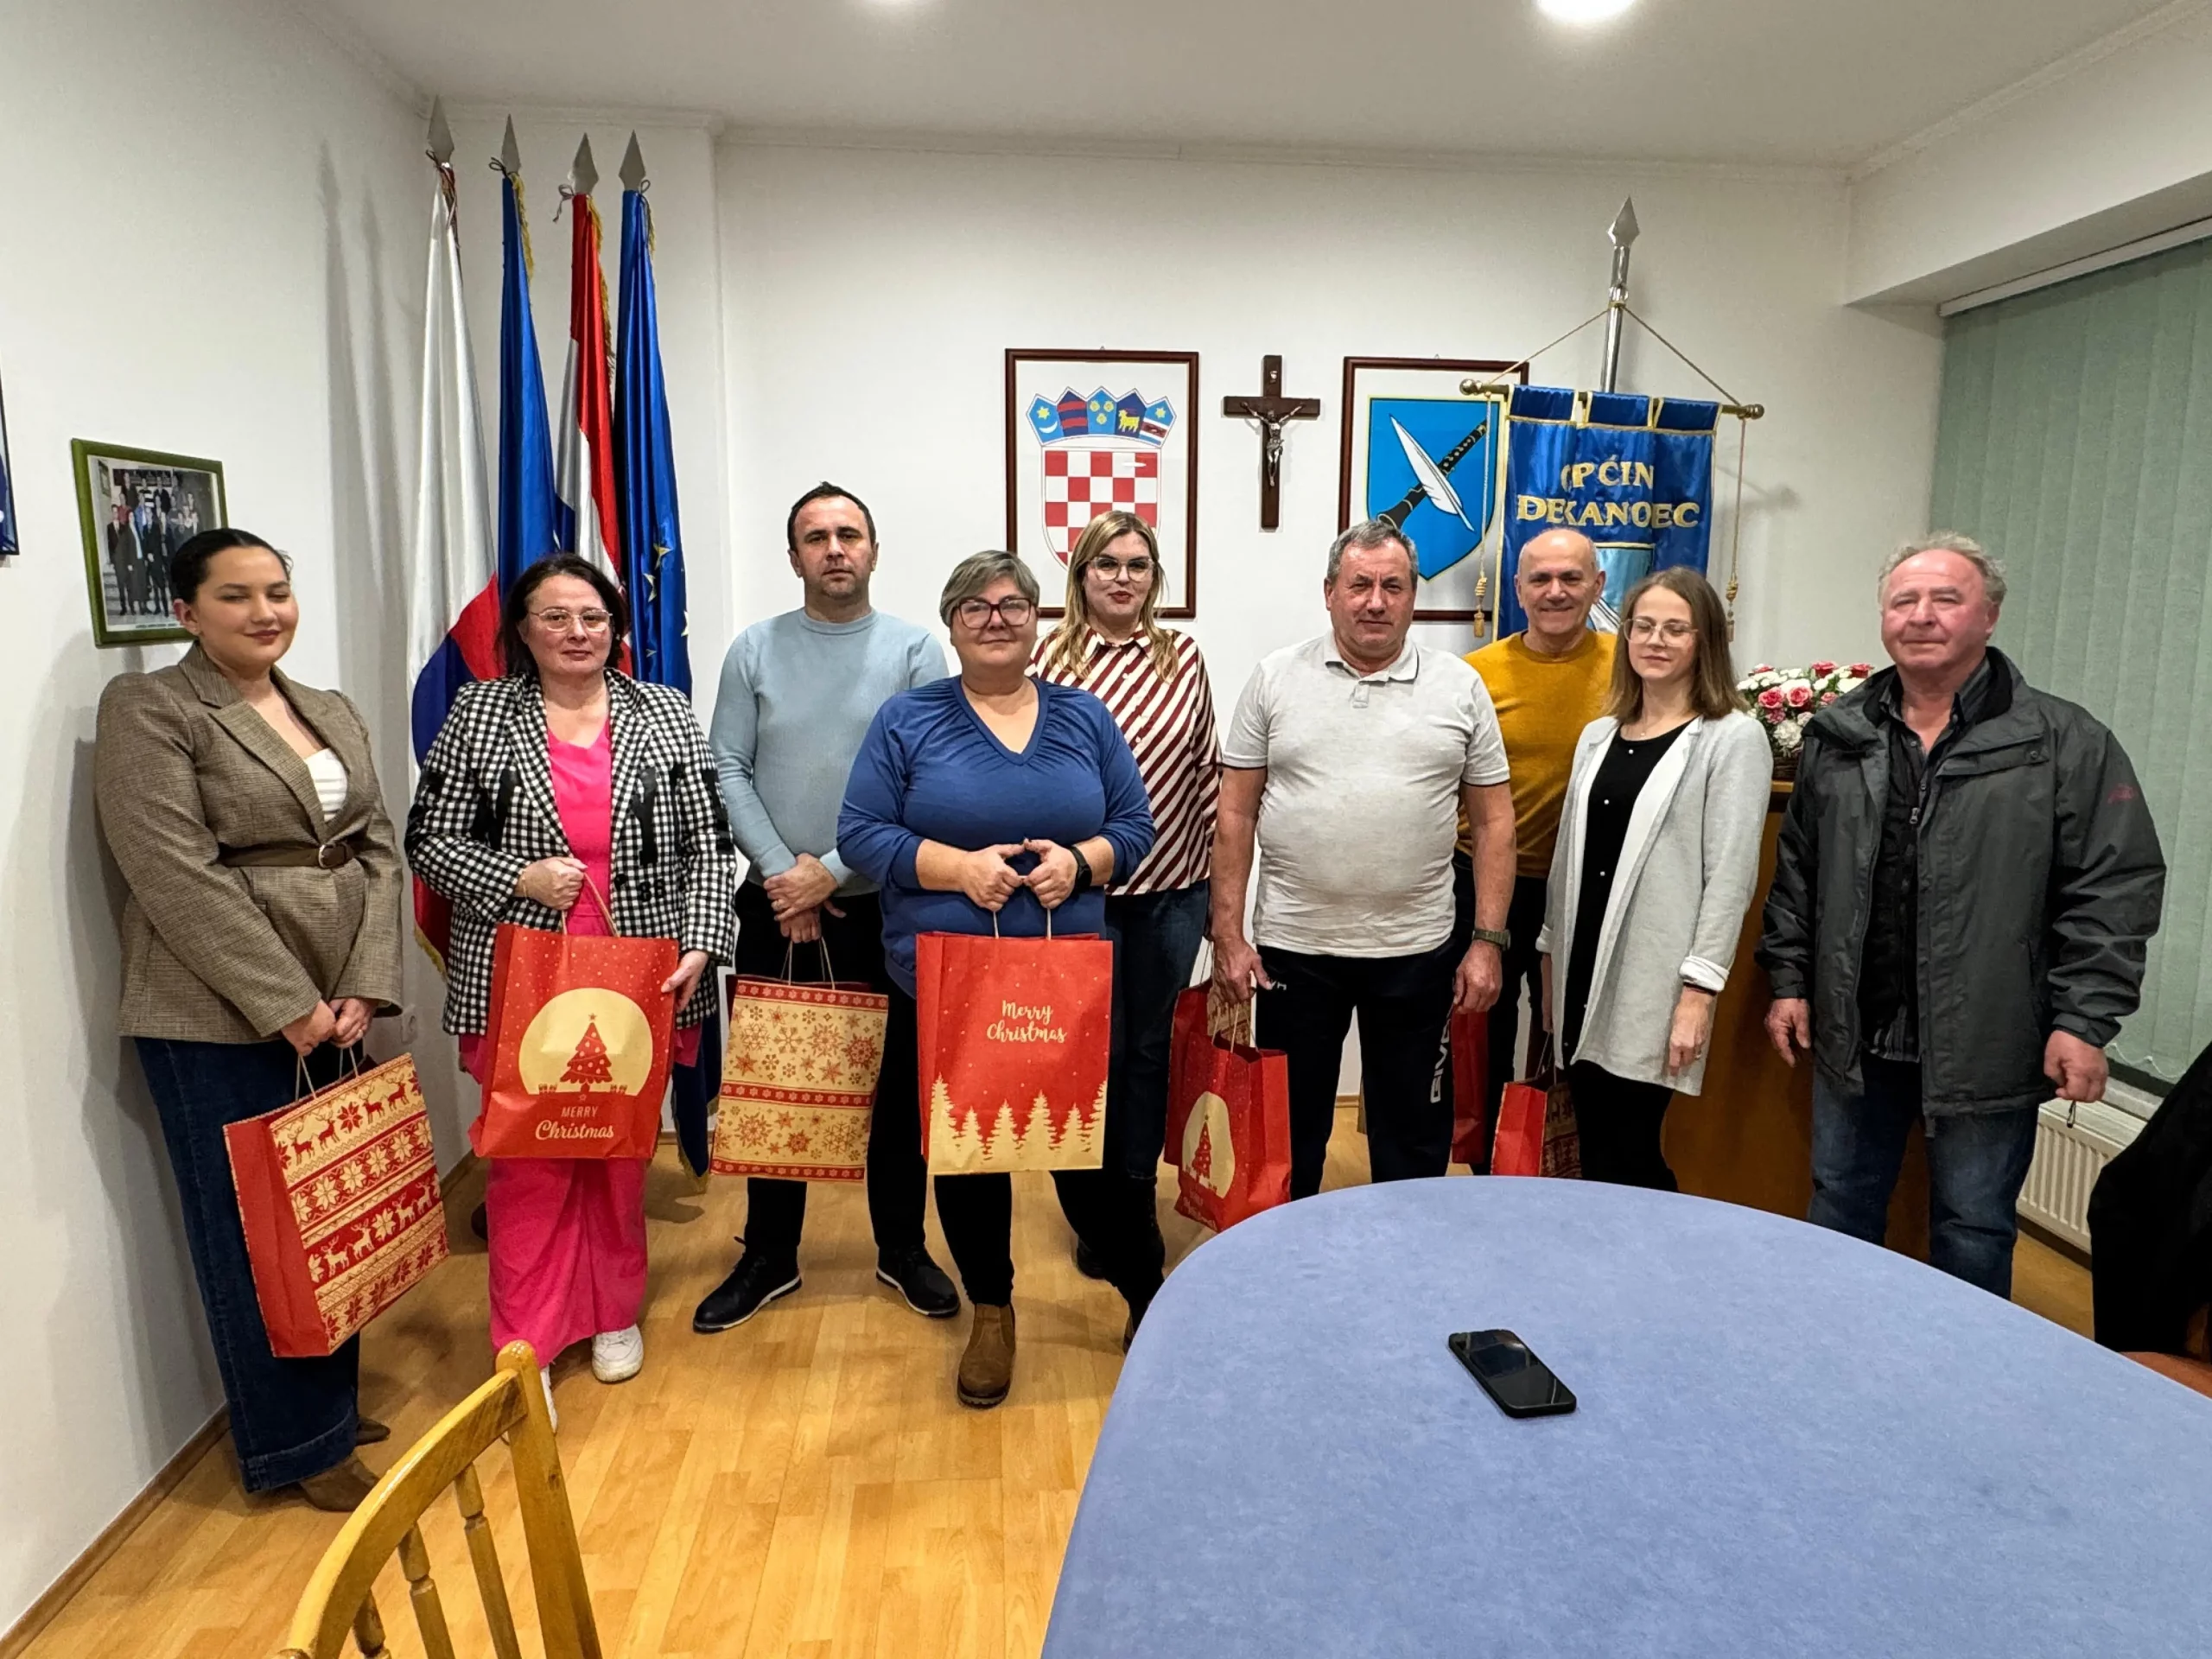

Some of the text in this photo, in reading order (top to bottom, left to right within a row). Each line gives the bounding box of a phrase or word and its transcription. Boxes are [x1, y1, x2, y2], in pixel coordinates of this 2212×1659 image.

[1560, 454, 1654, 491] PĆIN
[1517, 495, 1700, 528] DEKANOEC
[1001, 1000, 1054, 1025] Merry
[986, 1020, 1068, 1044] Christmas
[561, 1106, 599, 1118] MERRY
[535, 1120, 614, 1141] Christmas
